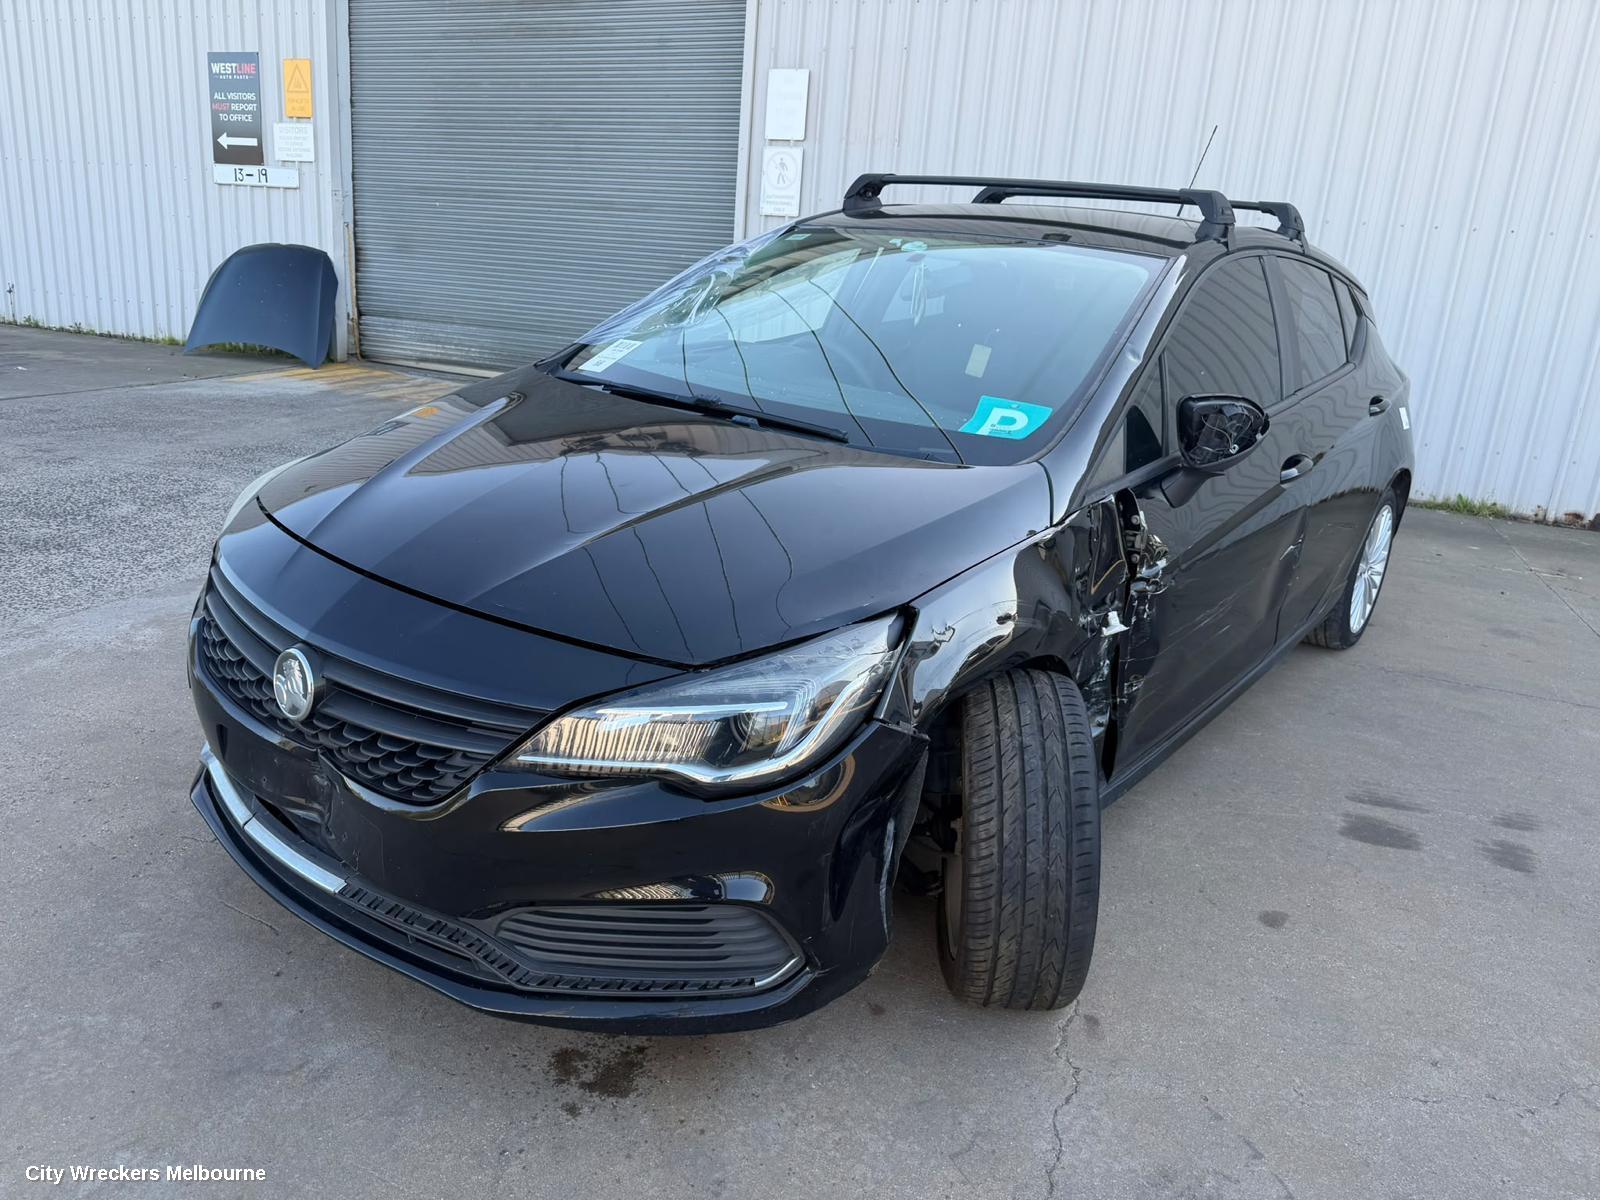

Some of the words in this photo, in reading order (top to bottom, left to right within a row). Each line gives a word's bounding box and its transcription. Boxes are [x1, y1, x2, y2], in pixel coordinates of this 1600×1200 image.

[211, 62, 256, 74] WESTLINE
[214, 92, 226, 100] ALL
[226, 92, 256, 100] VISITORS
[212, 102, 229, 110] MUST
[231, 103, 257, 111] REPORT
